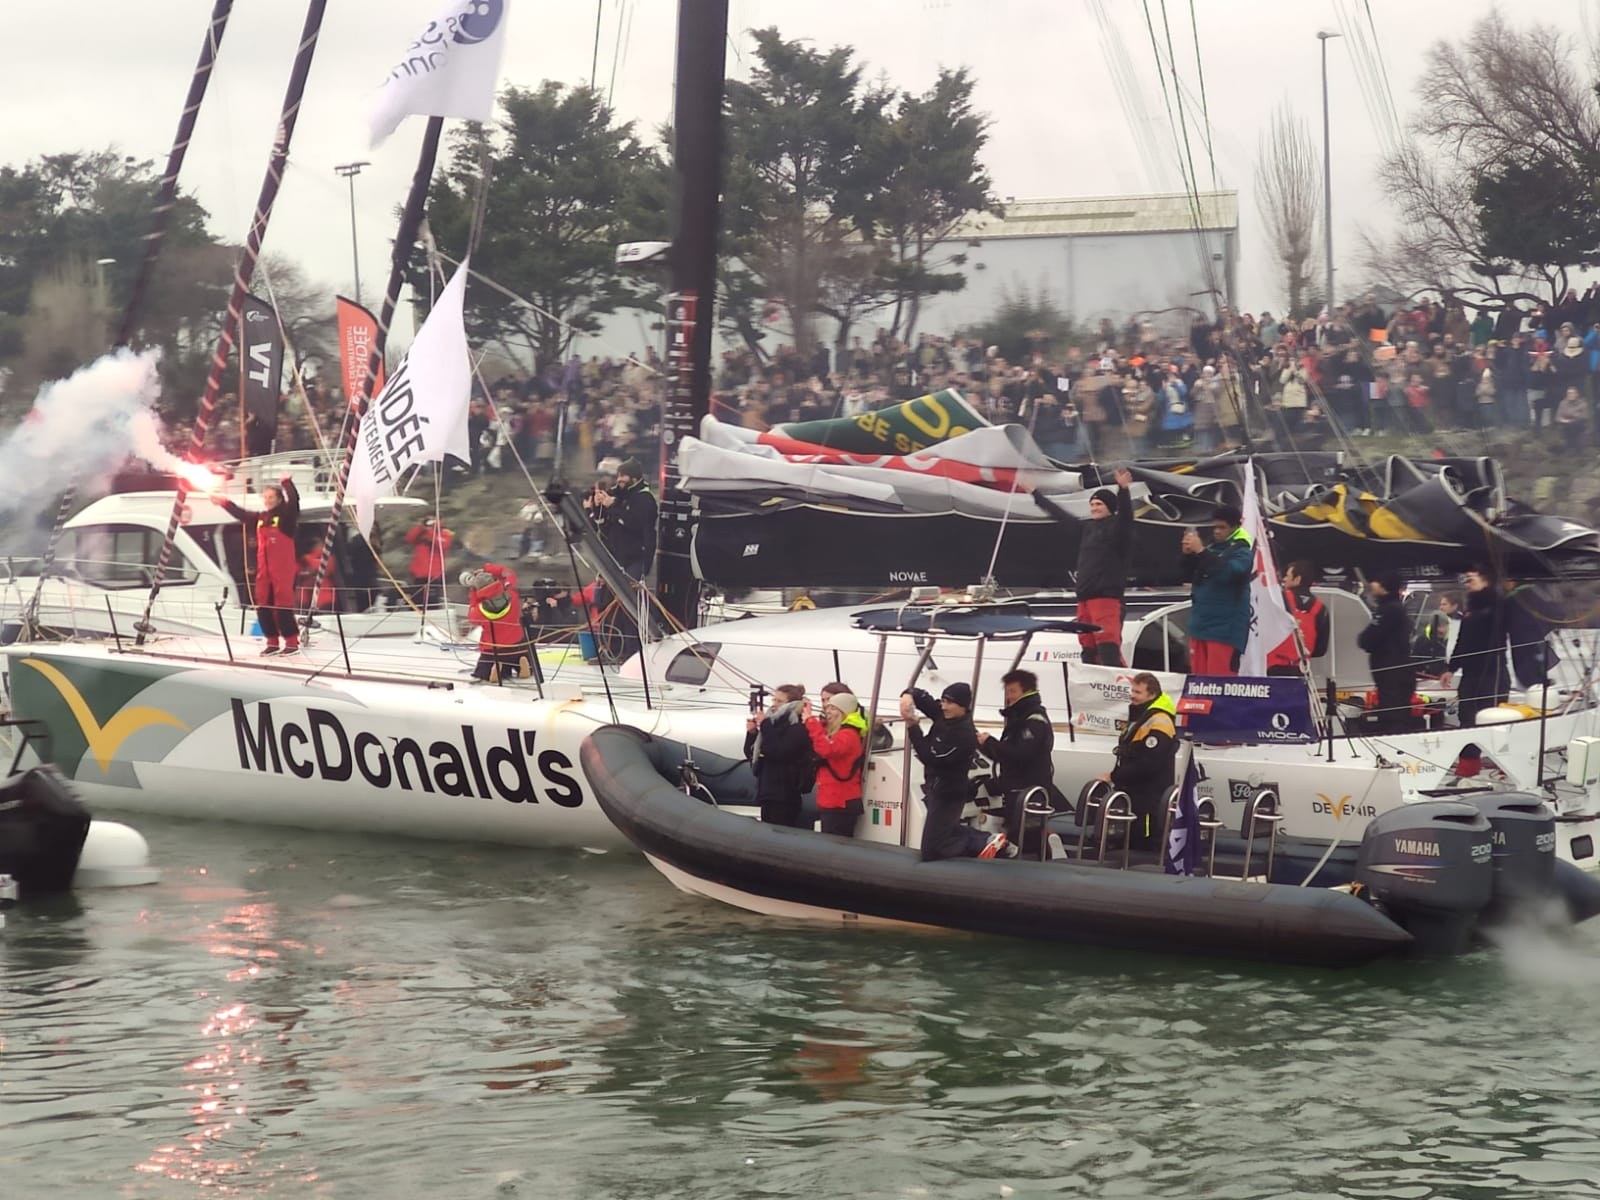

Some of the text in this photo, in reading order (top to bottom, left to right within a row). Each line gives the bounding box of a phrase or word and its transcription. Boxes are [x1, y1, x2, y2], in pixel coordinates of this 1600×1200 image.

[889, 571, 928, 582] NOVAE
[1052, 651, 1081, 659] Violett
[1188, 682, 1271, 698] Violette DORANGE
[1257, 731, 1311, 740] IMOCA
[231, 697, 584, 808] McDonald's
[1312, 792, 1377, 822] DEVENIR
[1536, 832, 1554, 845] 200
[1395, 839, 1440, 857] YAMAHA
[1471, 843, 1492, 857] 200
